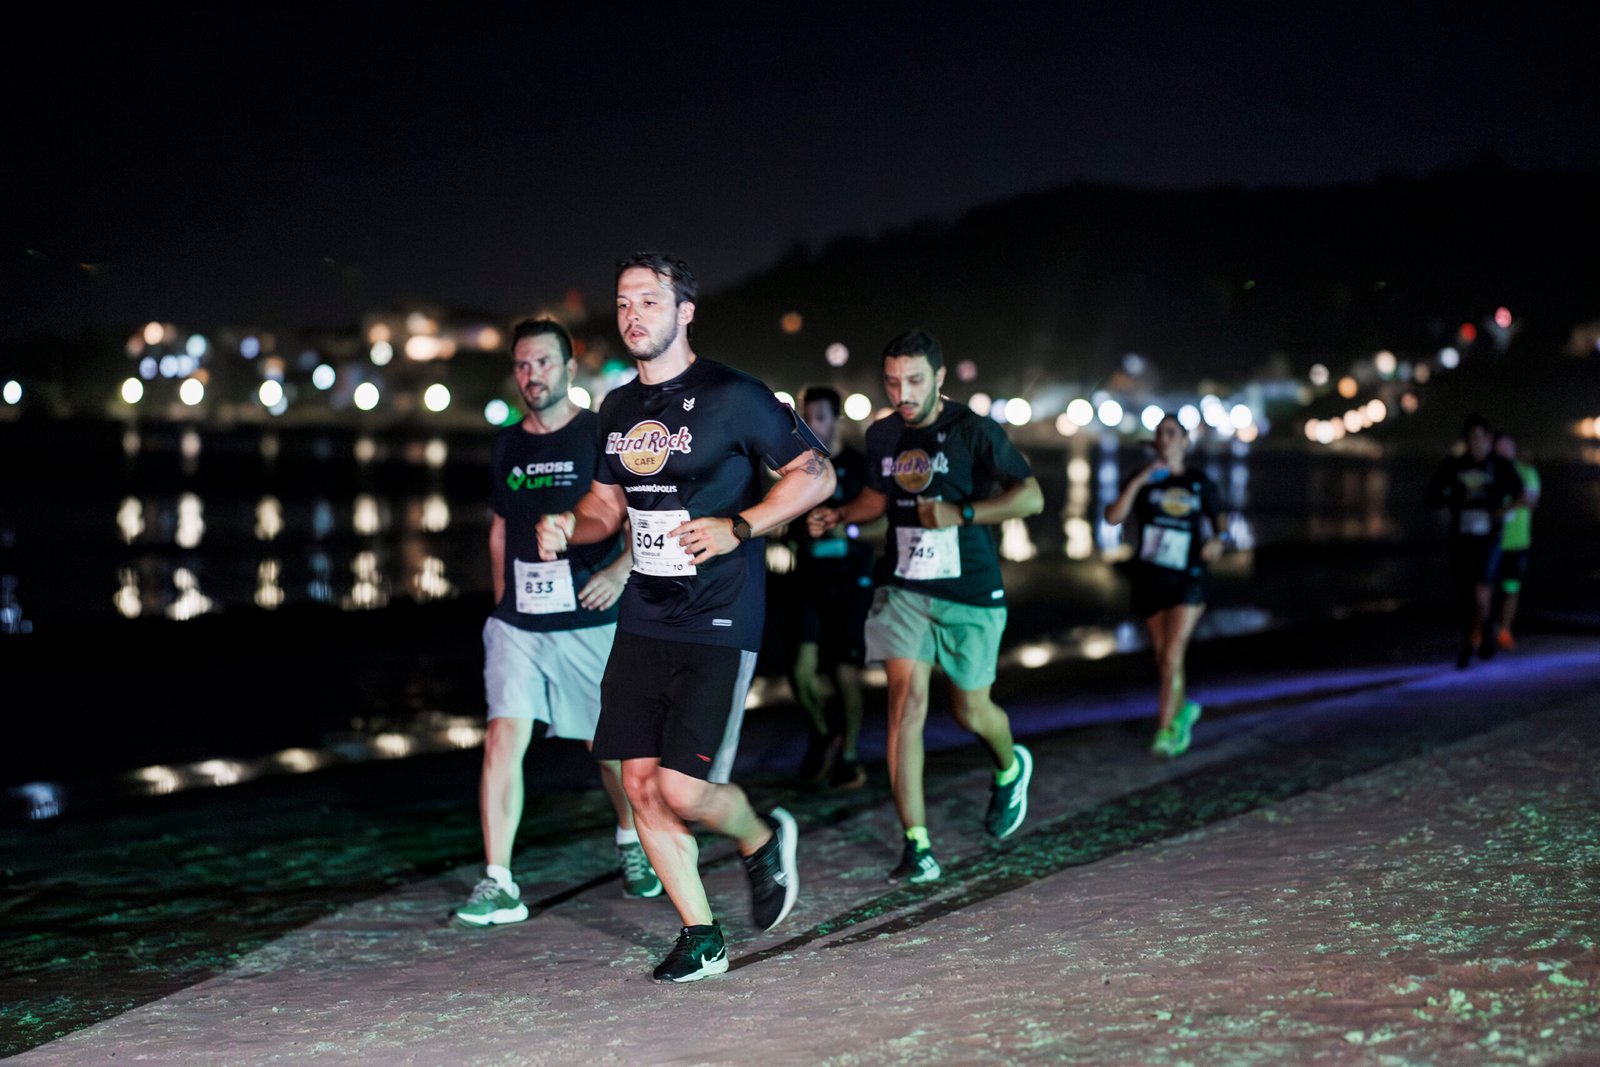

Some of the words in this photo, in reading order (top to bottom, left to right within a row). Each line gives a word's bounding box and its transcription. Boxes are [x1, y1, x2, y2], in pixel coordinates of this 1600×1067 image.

[605, 432, 647, 454] Hard
[647, 426, 692, 454] Rock
[526, 461, 574, 475] CROSS
[634, 457, 656, 466] CAFE
[637, 532, 664, 550] 504
[908, 546, 935, 559] 745
[525, 581, 553, 594] 833
